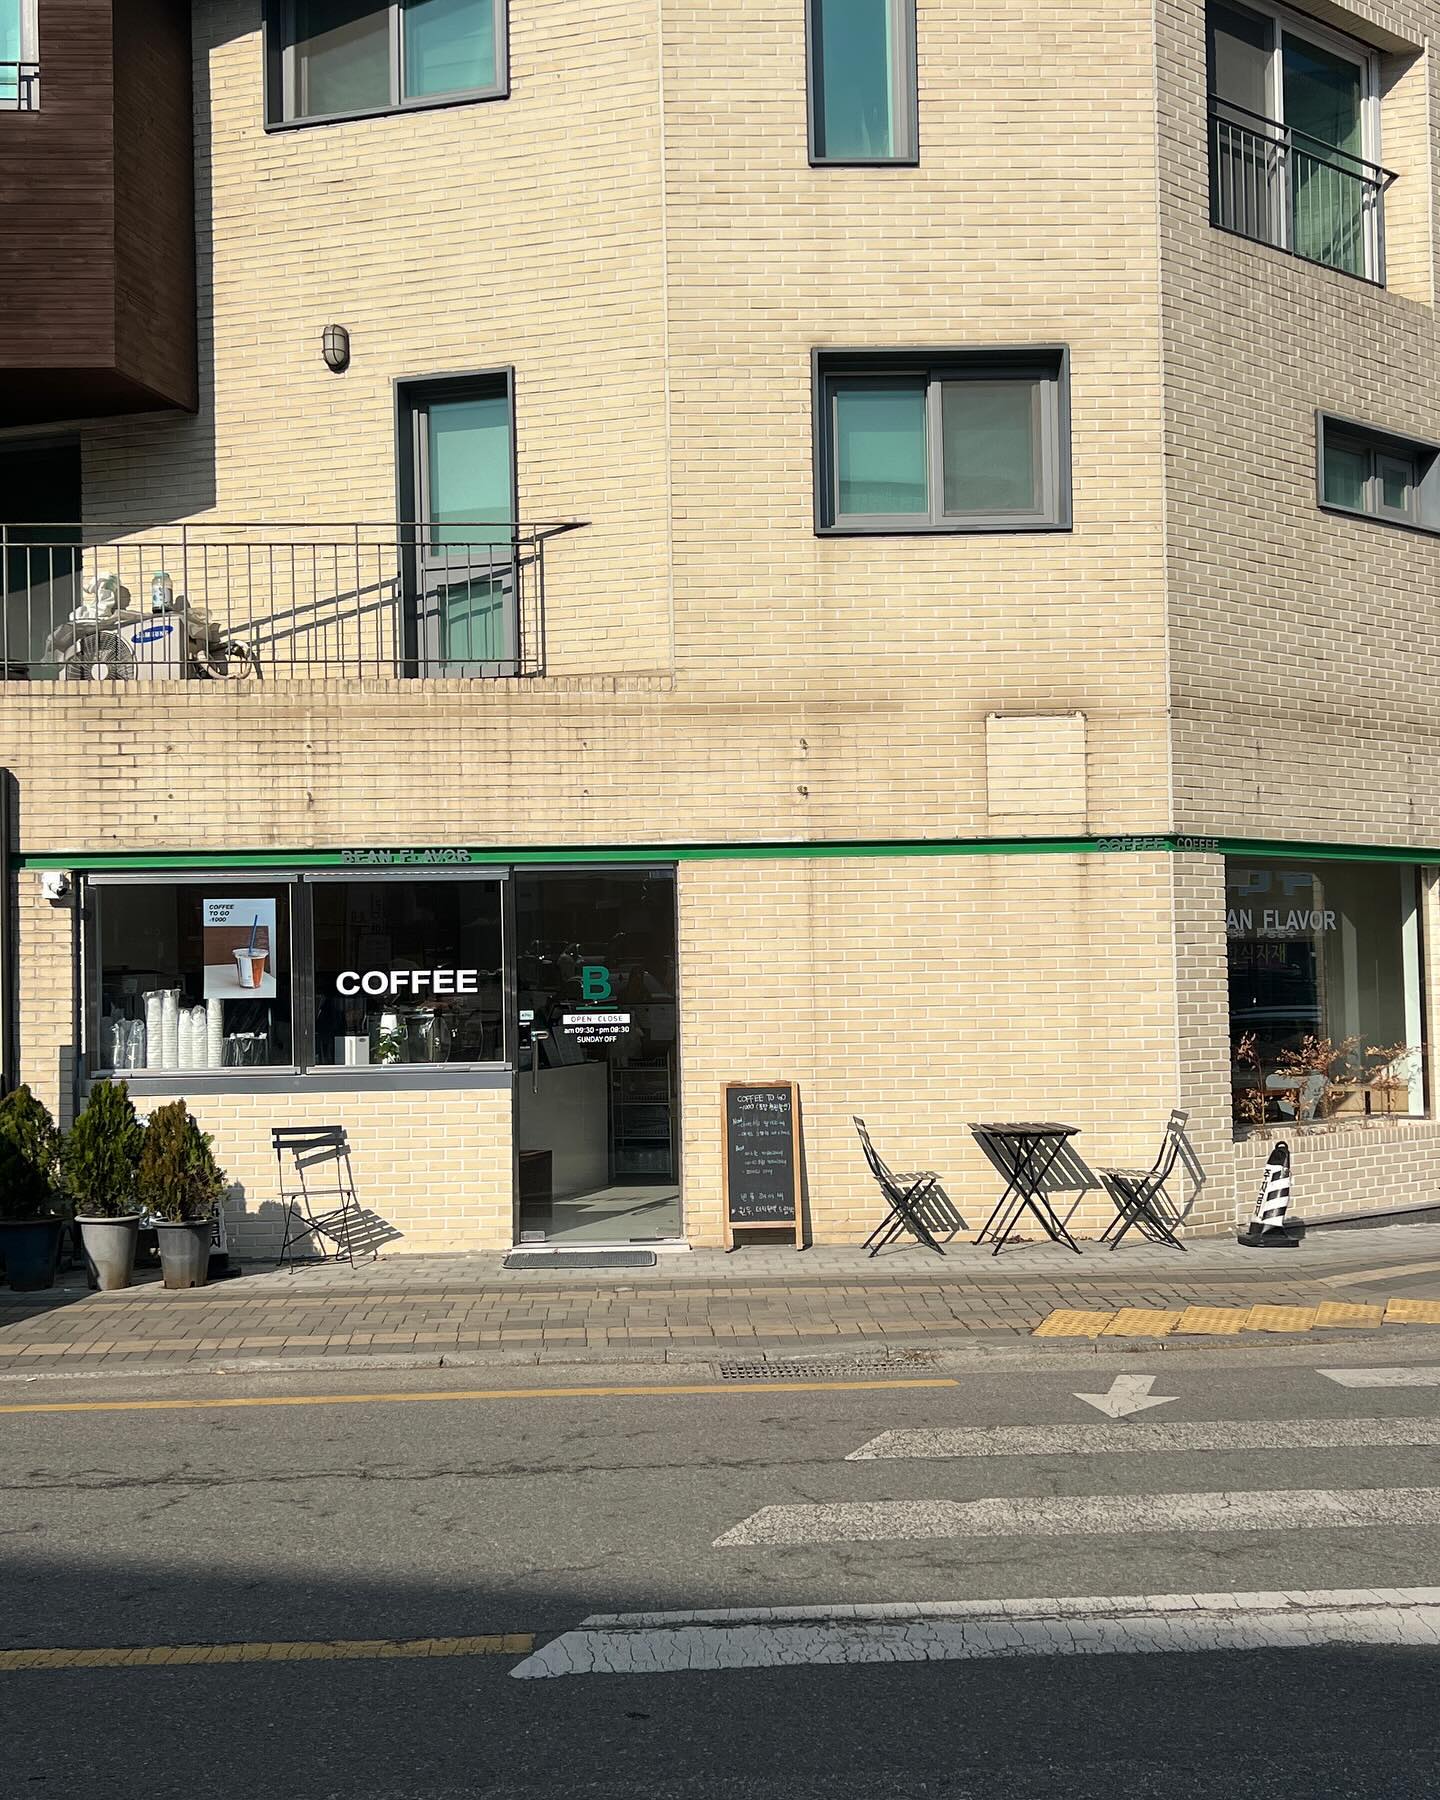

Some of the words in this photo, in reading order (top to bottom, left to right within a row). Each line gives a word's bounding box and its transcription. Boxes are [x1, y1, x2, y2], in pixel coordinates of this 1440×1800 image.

[1097, 838, 1166, 851] COFFEE
[1177, 838, 1219, 850] COFFEE
[341, 850, 392, 863] BEAN
[400, 849, 471, 863] FLAVOR
[1263, 909, 1337, 931] FLAVOR
[336, 969, 479, 995] COFFEE
[582, 965, 612, 1000] B
[599, 1027, 610, 1035] pm
[737, 1094, 764, 1103] COFFEE
